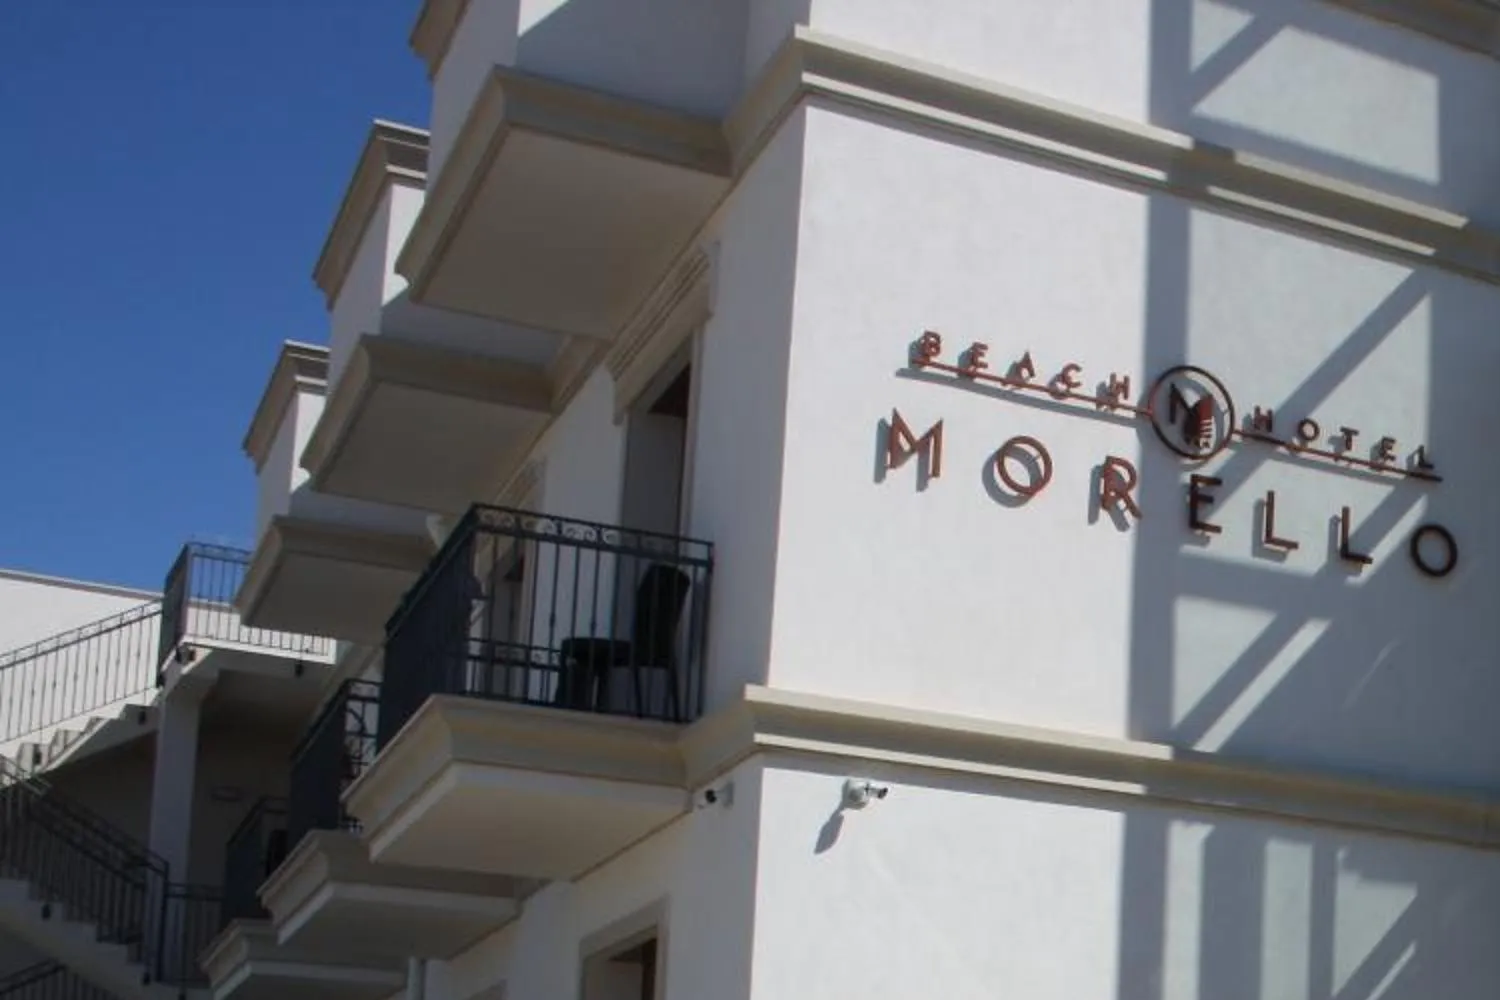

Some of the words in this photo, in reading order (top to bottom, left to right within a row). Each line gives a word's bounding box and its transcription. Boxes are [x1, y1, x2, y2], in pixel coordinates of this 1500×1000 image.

[919, 329, 1131, 402] BEACH
[1252, 405, 1435, 470] HOTEL
[887, 407, 1459, 577] MORELLO
